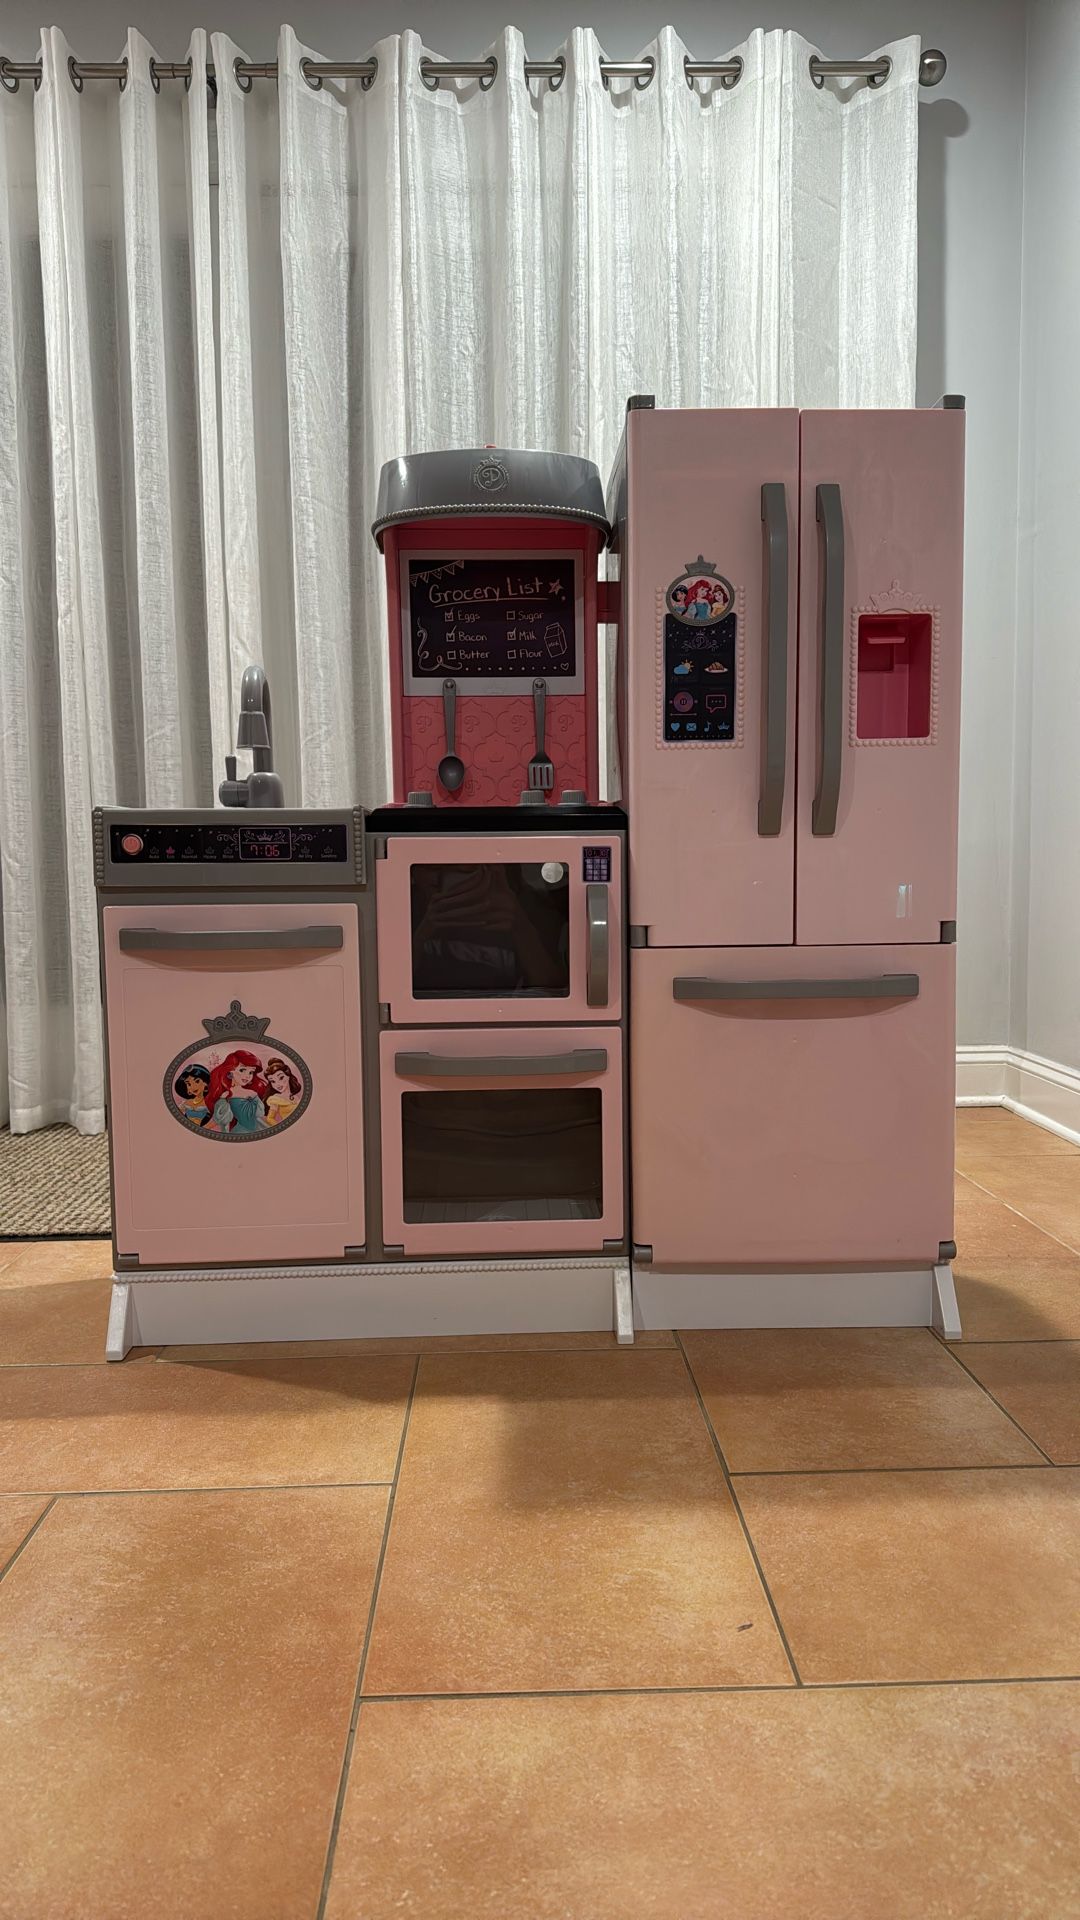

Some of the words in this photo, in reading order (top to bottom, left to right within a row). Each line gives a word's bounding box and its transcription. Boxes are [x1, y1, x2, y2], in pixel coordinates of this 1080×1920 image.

[429, 584, 500, 602] Grocery
[507, 577, 543, 596] List
[458, 611, 481, 622] Eggs
[518, 611, 544, 622] Sugar
[458, 633, 488, 641] Bacon
[519, 632, 537, 641] Milk
[458, 650, 490, 659] Butter
[520, 650, 543, 659] Flour
[251, 845, 280, 857] 7:06
